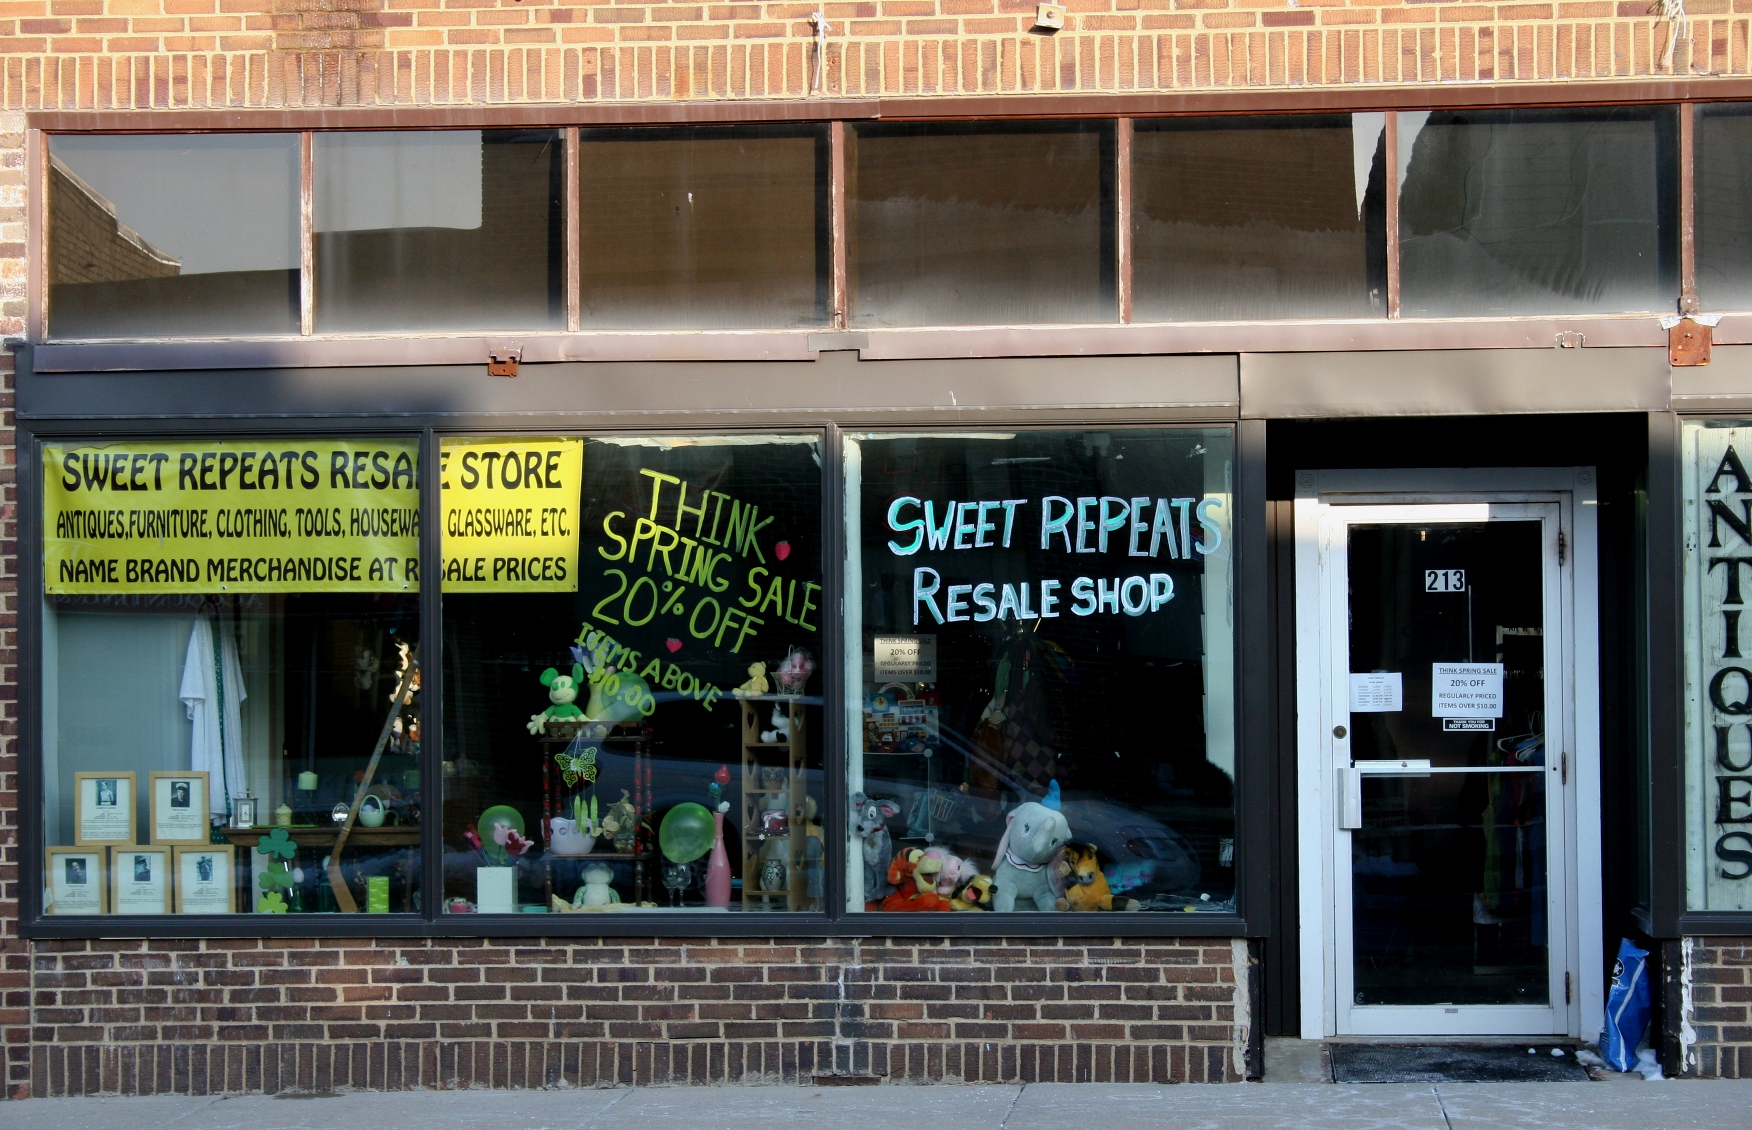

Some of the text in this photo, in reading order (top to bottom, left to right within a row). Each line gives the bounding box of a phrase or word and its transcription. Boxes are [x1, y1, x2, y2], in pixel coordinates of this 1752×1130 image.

[62, 451, 562, 492] SWEET REPEATS RESAE STORE
[217, 508, 291, 539] CLOTHING,
[295, 508, 345, 539] TOOLS,
[449, 508, 536, 539] GLASSWARE,
[541, 508, 570, 537] ETC.
[640, 468, 775, 564] THINK
[887, 495, 1223, 560] SWEET REPEATS
[60, 557, 567, 583] NAME BRAND MERCHANDISE AT RALE PRICES
[598, 511, 822, 632] SPRING SALE
[1070, 573, 1175, 617] SHOP
[1427, 570, 1464, 591] 213
[592, 569, 765, 654] 20% OFF
[574, 622, 723, 712] ITEMS ABOVE
[1450, 679, 1486, 687] 20% OFF
[1705, 444, 1752, 880] ANTIQUES
